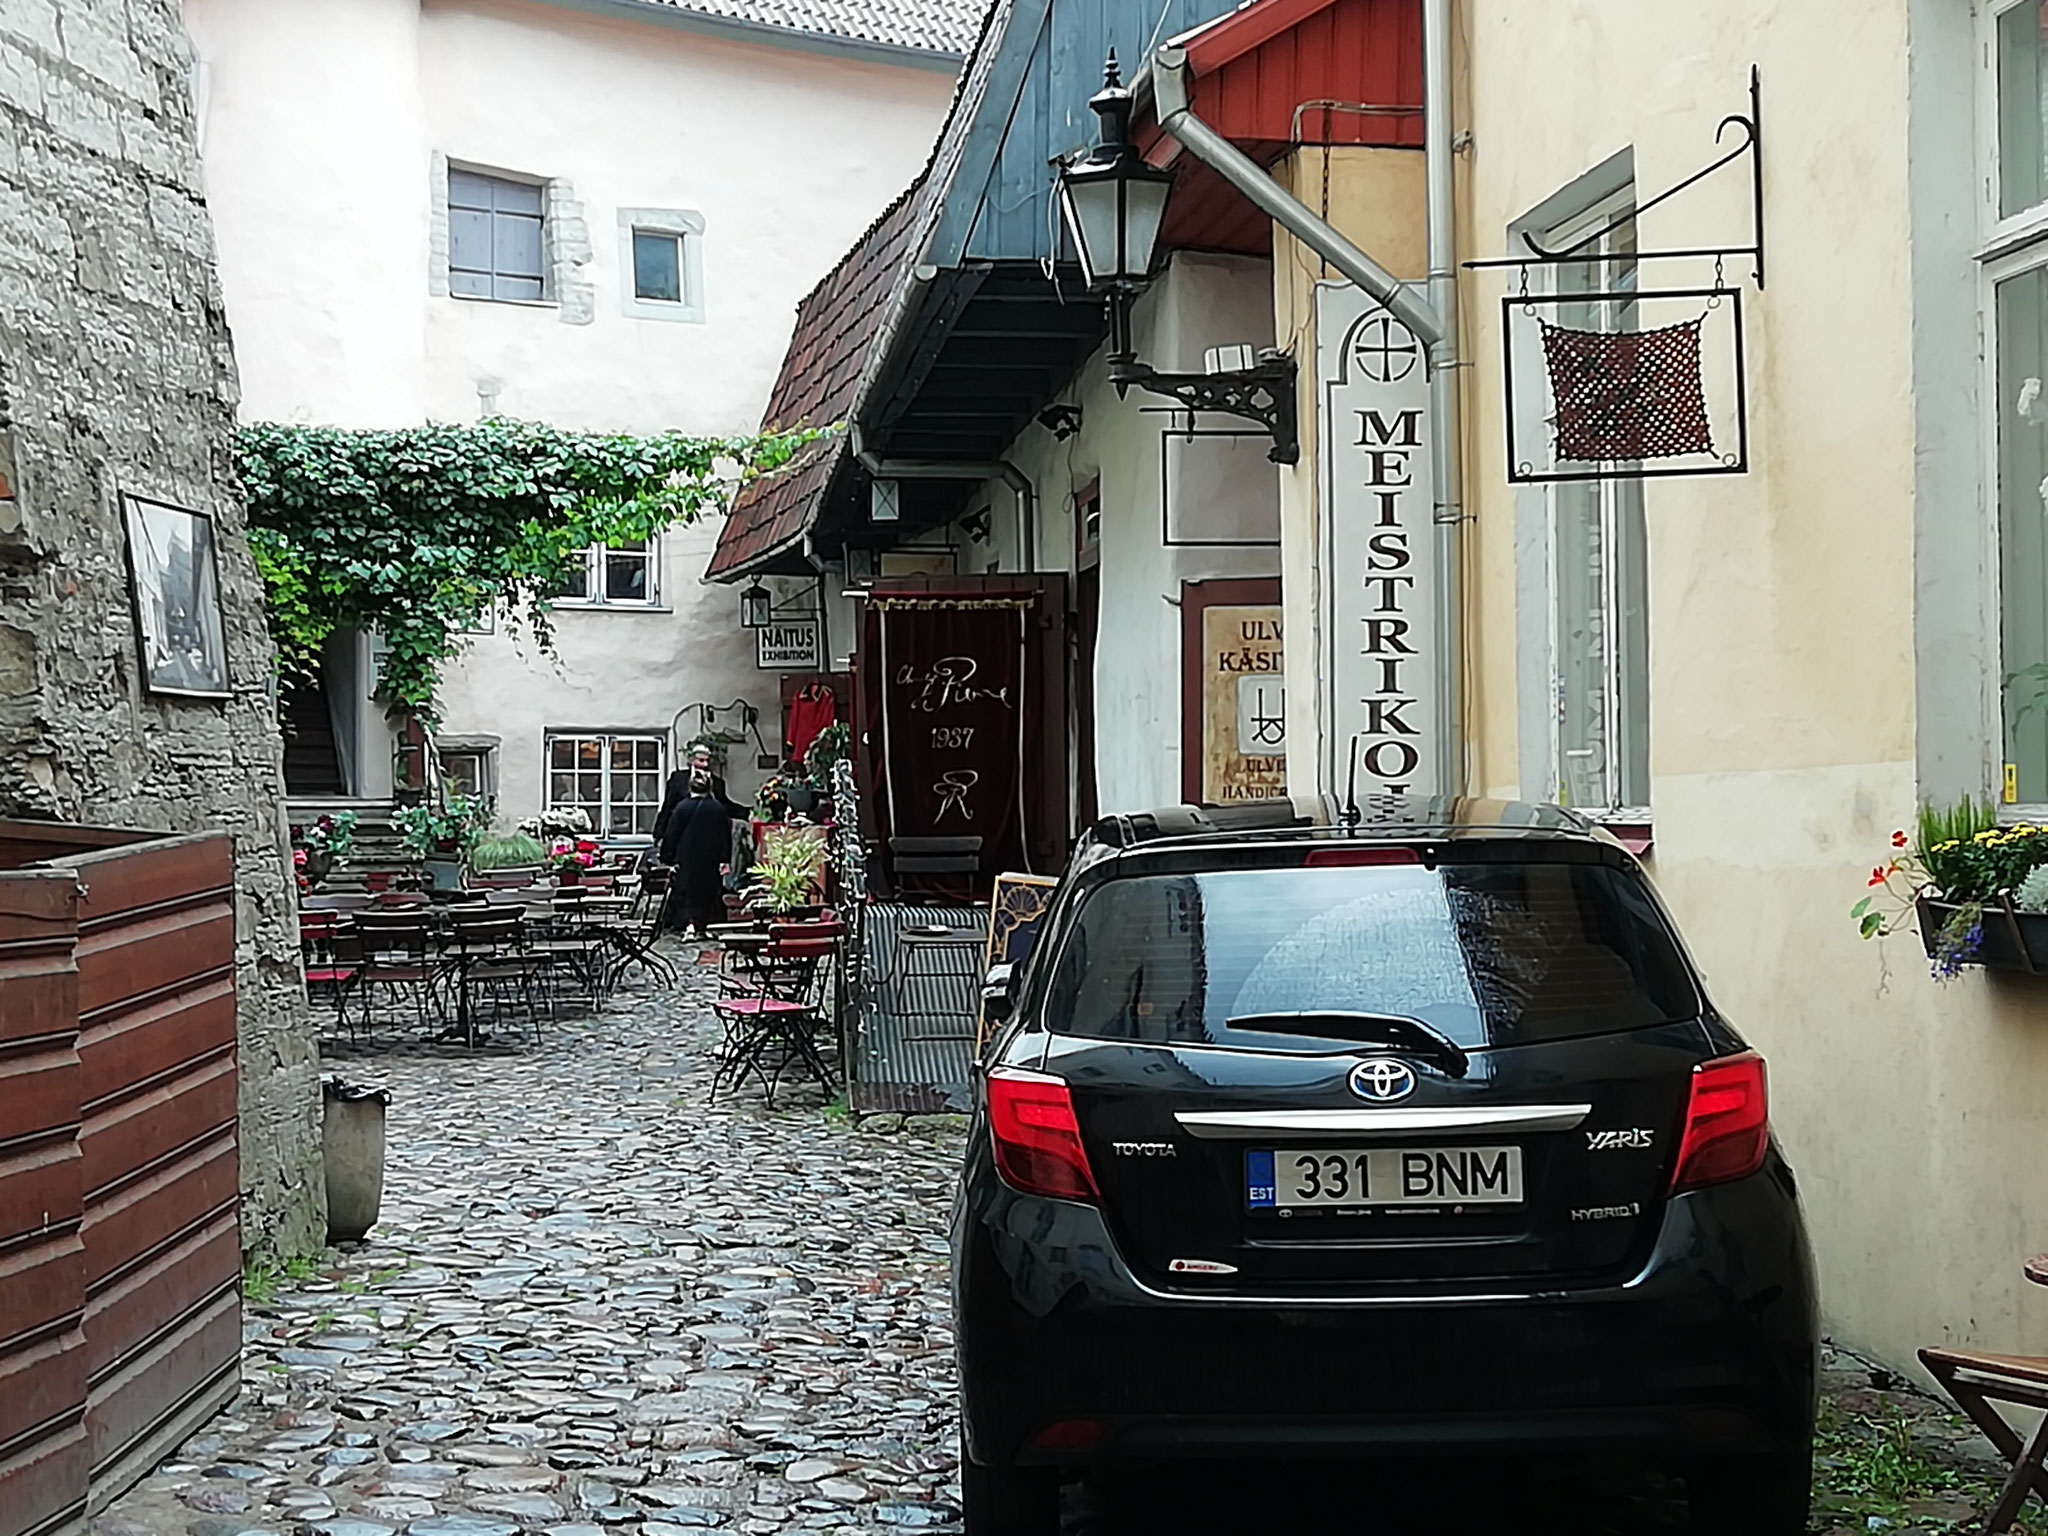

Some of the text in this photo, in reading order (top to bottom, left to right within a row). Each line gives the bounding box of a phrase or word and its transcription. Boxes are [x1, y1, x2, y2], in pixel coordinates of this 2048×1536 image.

[761, 625, 814, 648] NÄITUS
[762, 650, 814, 661] EXHIBITION
[931, 726, 975, 749] 1937
[1585, 1127, 1654, 1150] YARIS
[1112, 1142, 1177, 1157] TOYOTA
[1294, 1151, 1509, 1199] 331 BNM
[1249, 1187, 1274, 1200] EST
[1570, 1205, 1633, 1221] HYBRID
